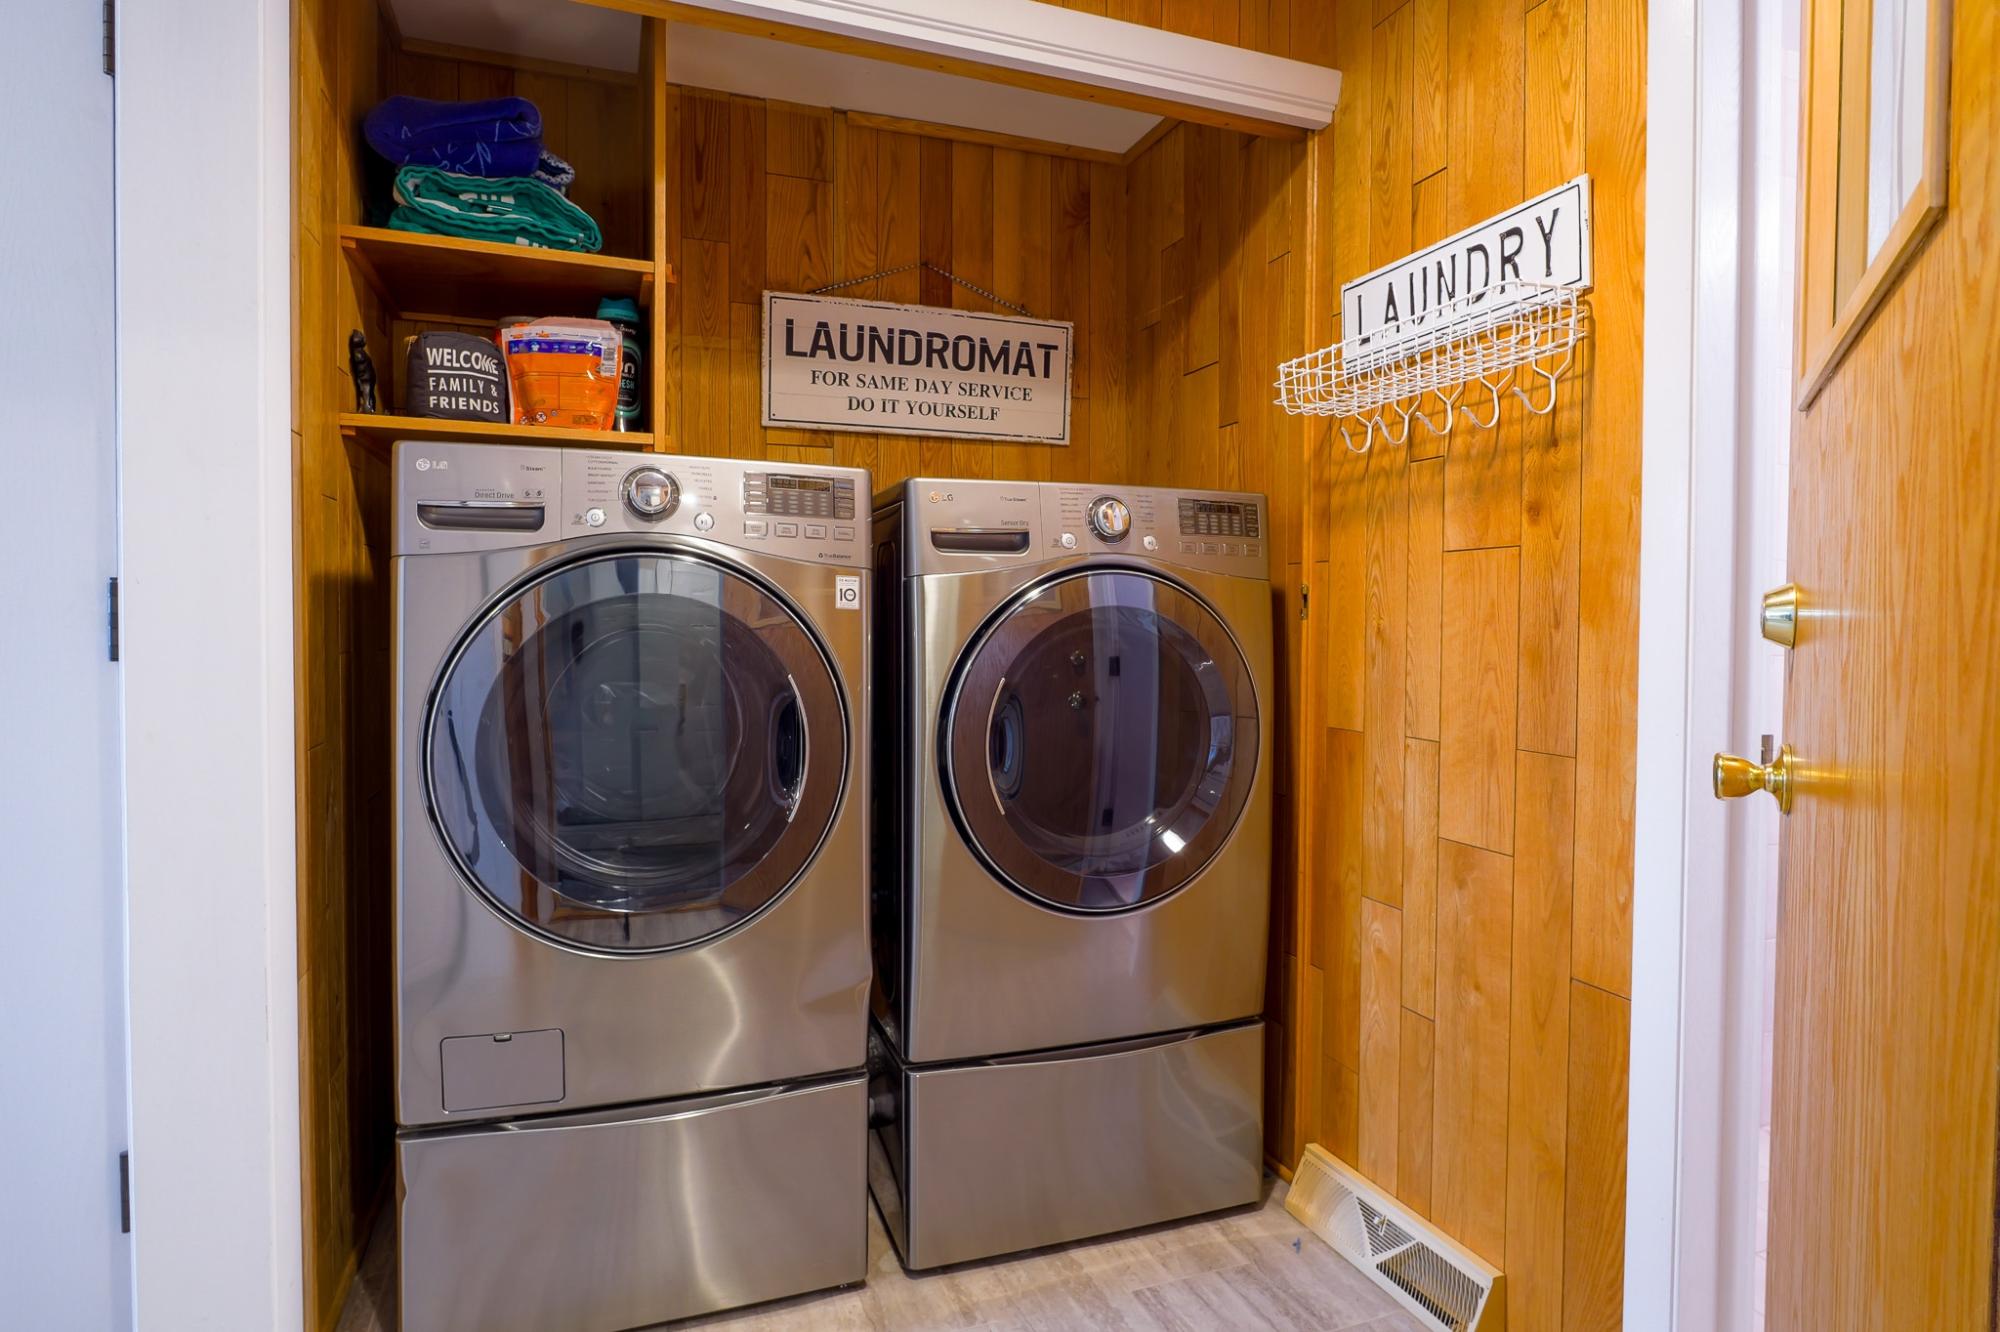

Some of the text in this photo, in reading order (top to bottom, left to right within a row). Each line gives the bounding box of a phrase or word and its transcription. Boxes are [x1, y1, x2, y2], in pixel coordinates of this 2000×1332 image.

[1357, 207, 1561, 346] LAUNDRY
[426, 347, 500, 375] WELCOME
[784, 318, 1059, 379] LAUNDROMAT
[429, 376, 499, 397] FAMILY &
[810, 369, 1033, 402] FOR SAME DAY SERVICE
[429, 396, 500, 414] FRIENDS
[847, 396, 1001, 421] DO IT YOURSELF
[474, 491, 515, 499] Direct Drive
[839, 588, 857, 602] 10
